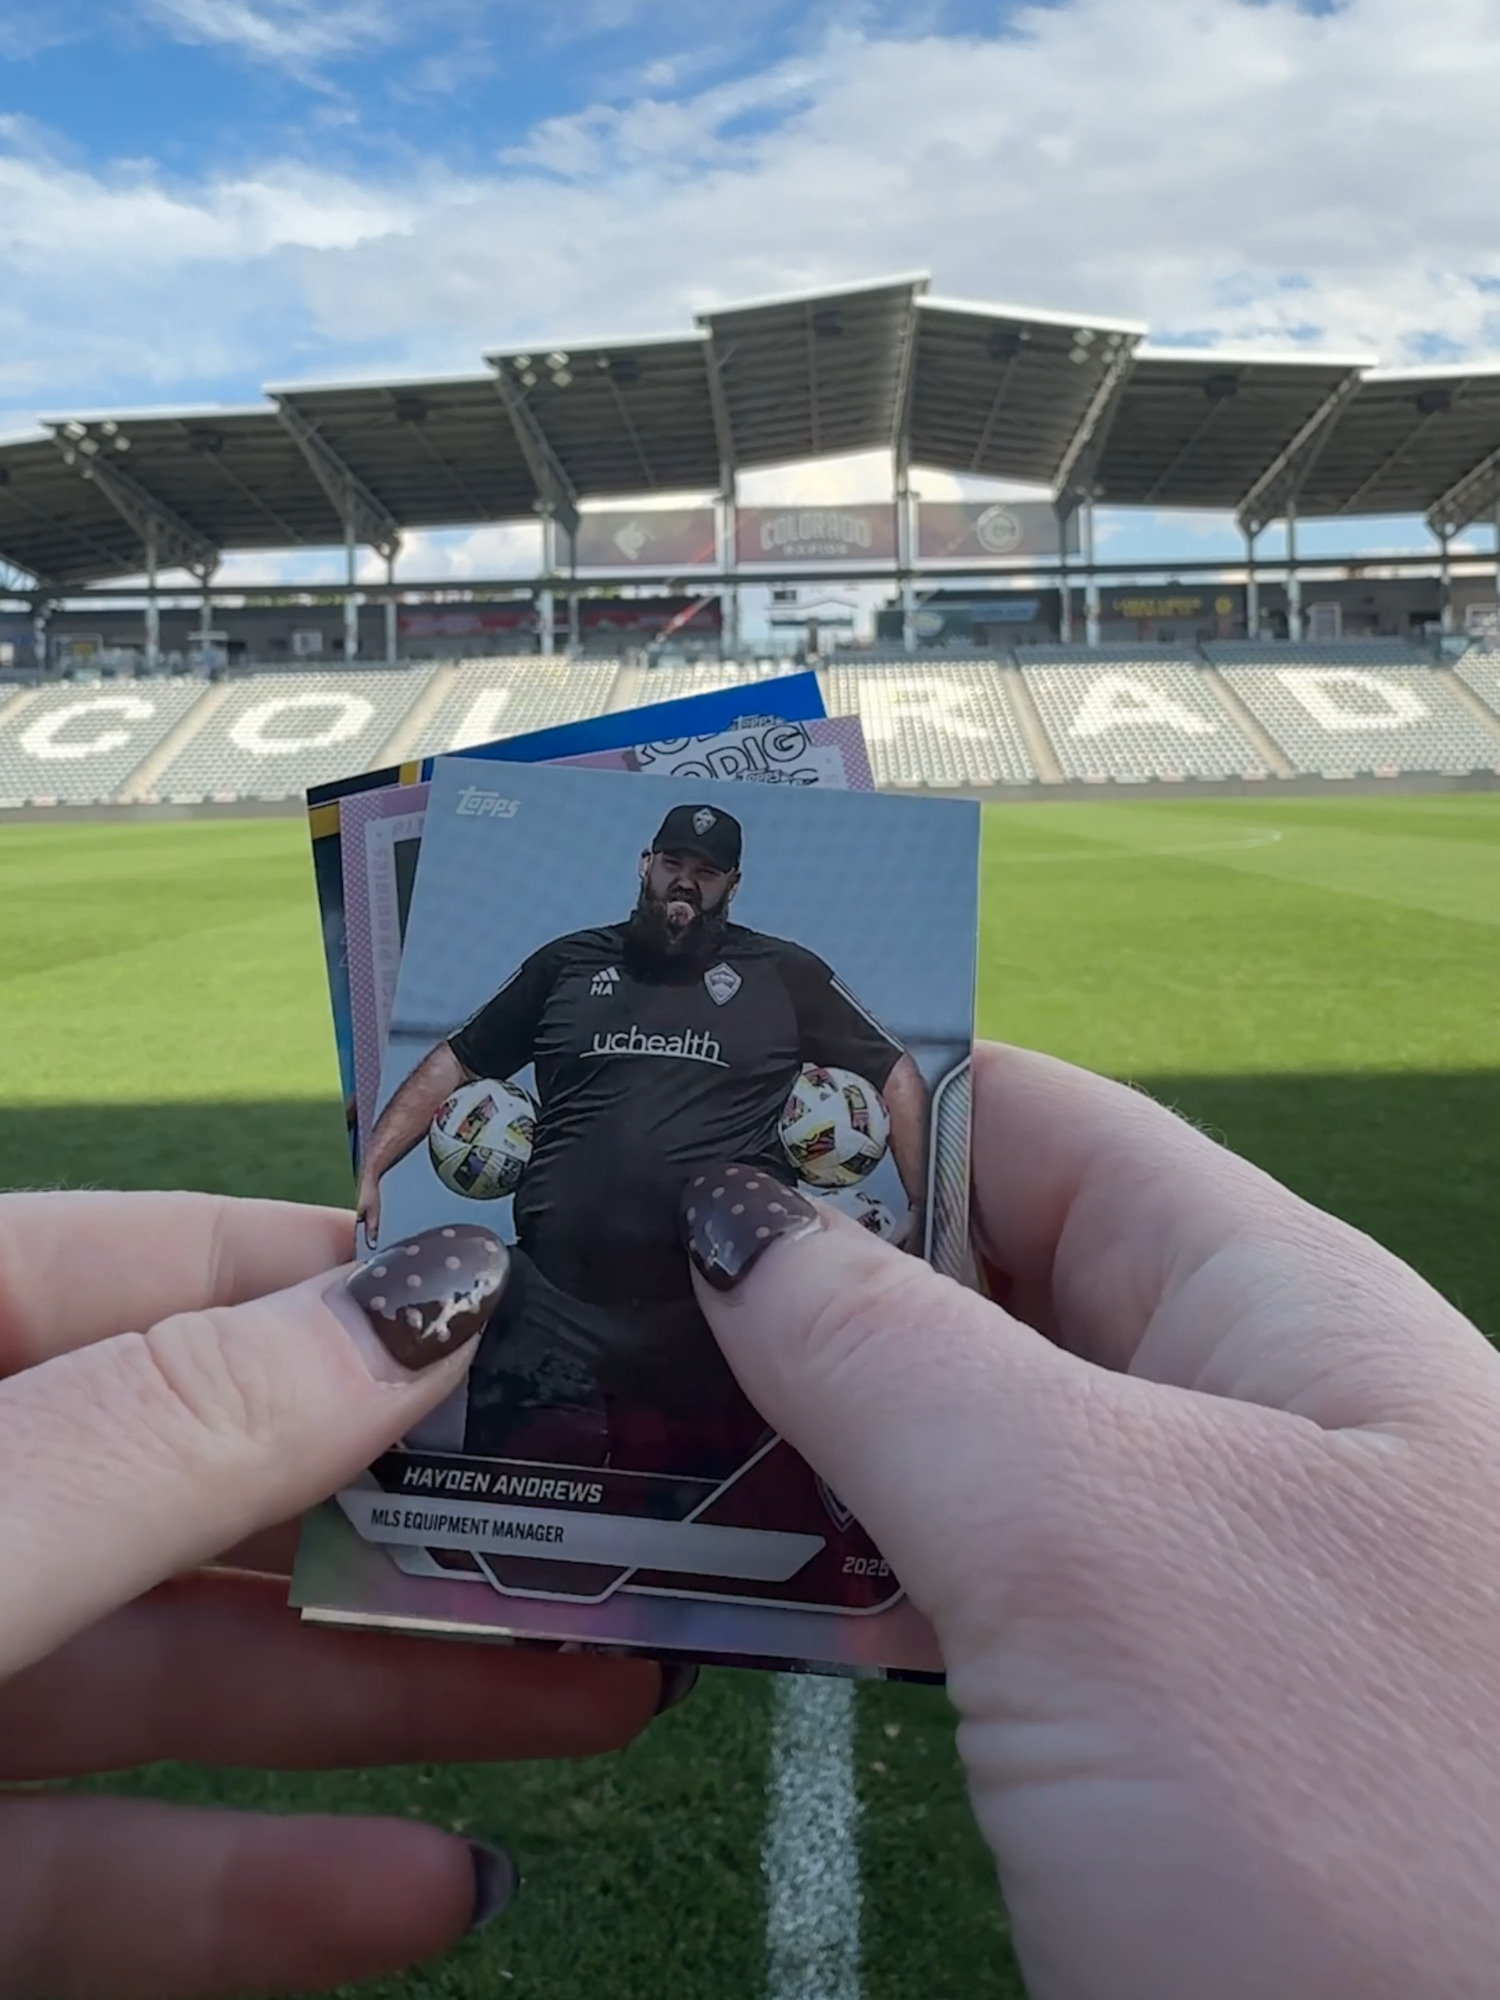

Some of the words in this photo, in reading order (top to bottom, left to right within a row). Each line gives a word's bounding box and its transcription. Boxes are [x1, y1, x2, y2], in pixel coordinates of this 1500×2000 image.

[760, 511, 873, 551] COLORADO
[589, 982, 614, 997] HA
[592, 1024, 721, 1063] uchealth
[402, 1465, 490, 1493] HAYDEN
[492, 1474, 603, 1504] ANDREWS
[370, 1508, 402, 1527] MLS
[403, 1511, 490, 1536] EQUIPMENT
[492, 1520, 564, 1543] MANAGER
